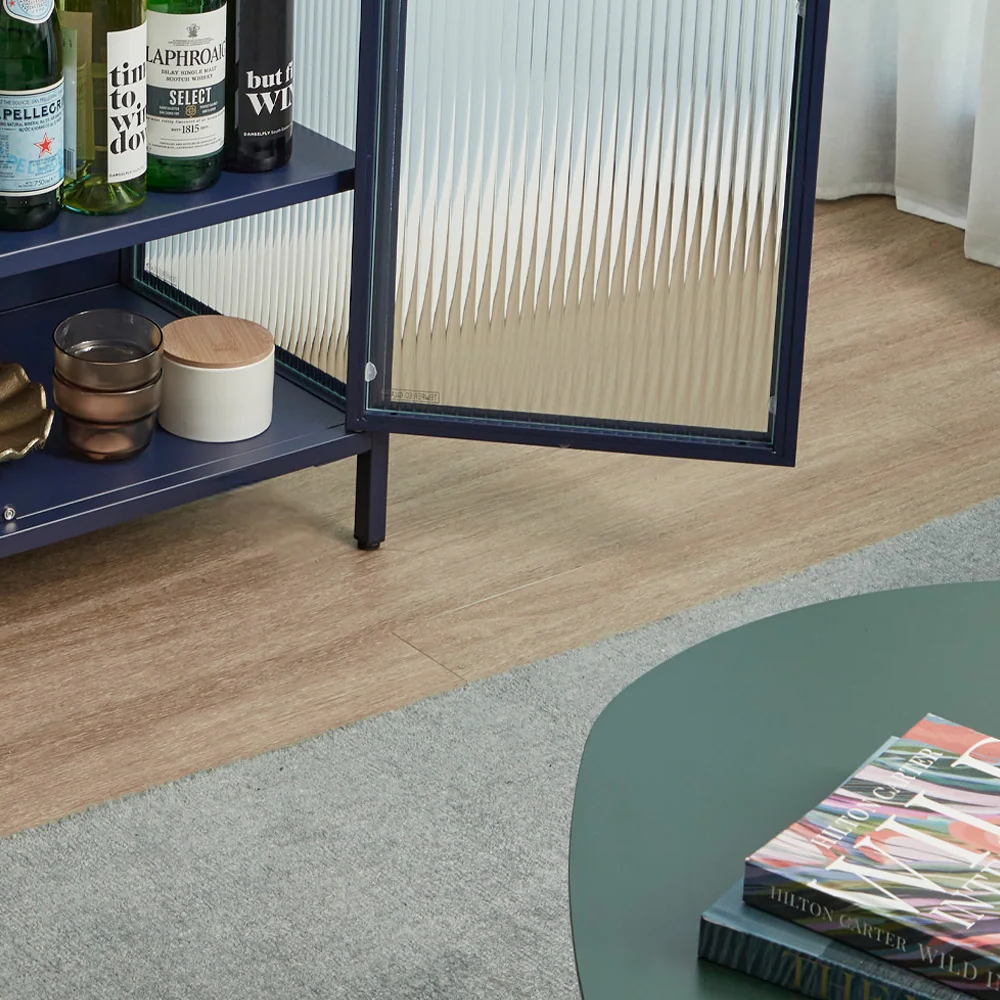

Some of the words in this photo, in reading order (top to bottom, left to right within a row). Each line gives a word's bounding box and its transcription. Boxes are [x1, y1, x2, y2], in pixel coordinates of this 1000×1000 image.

[161, 68, 179, 76] ISLAY
[246, 69, 283, 90] but
[109, 88, 136, 110] to
[169, 87, 212, 106] SELECT
[182, 124, 200, 134] 1815
[810, 797, 881, 850] HILTON
[872, 748, 944, 800] CARTER
[770, 886, 833, 922] HILTON
[839, 914, 907, 952] CARTER
[918, 943, 978, 981] WILD
